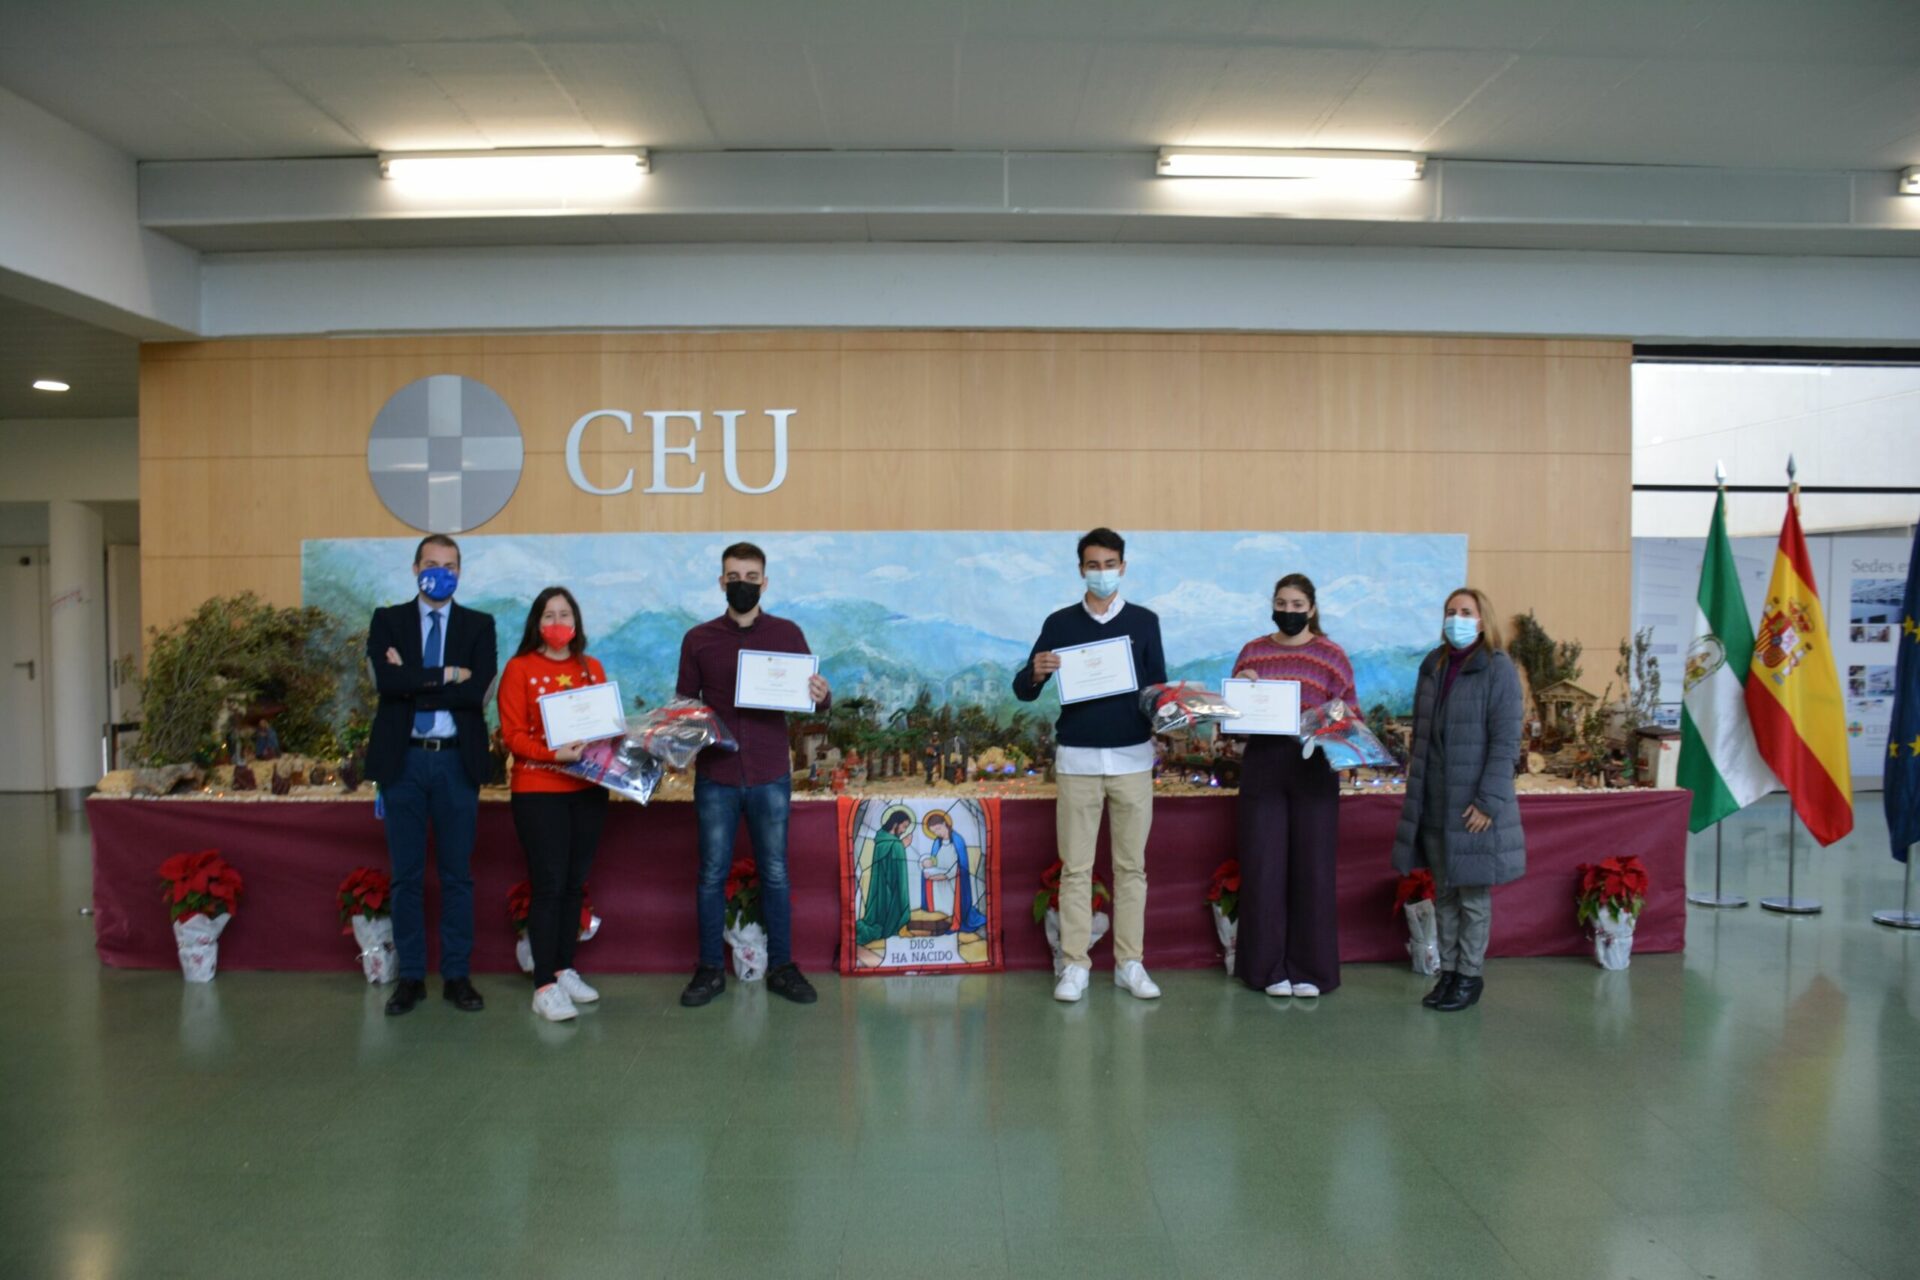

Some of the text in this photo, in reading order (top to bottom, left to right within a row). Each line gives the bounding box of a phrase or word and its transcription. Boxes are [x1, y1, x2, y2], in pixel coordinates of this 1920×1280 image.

[565, 408, 797, 496] CEU
[1851, 558, 1895, 573] Sedes
[910, 938, 934, 949] DIOS
[892, 951, 953, 963] HA NACIDO
